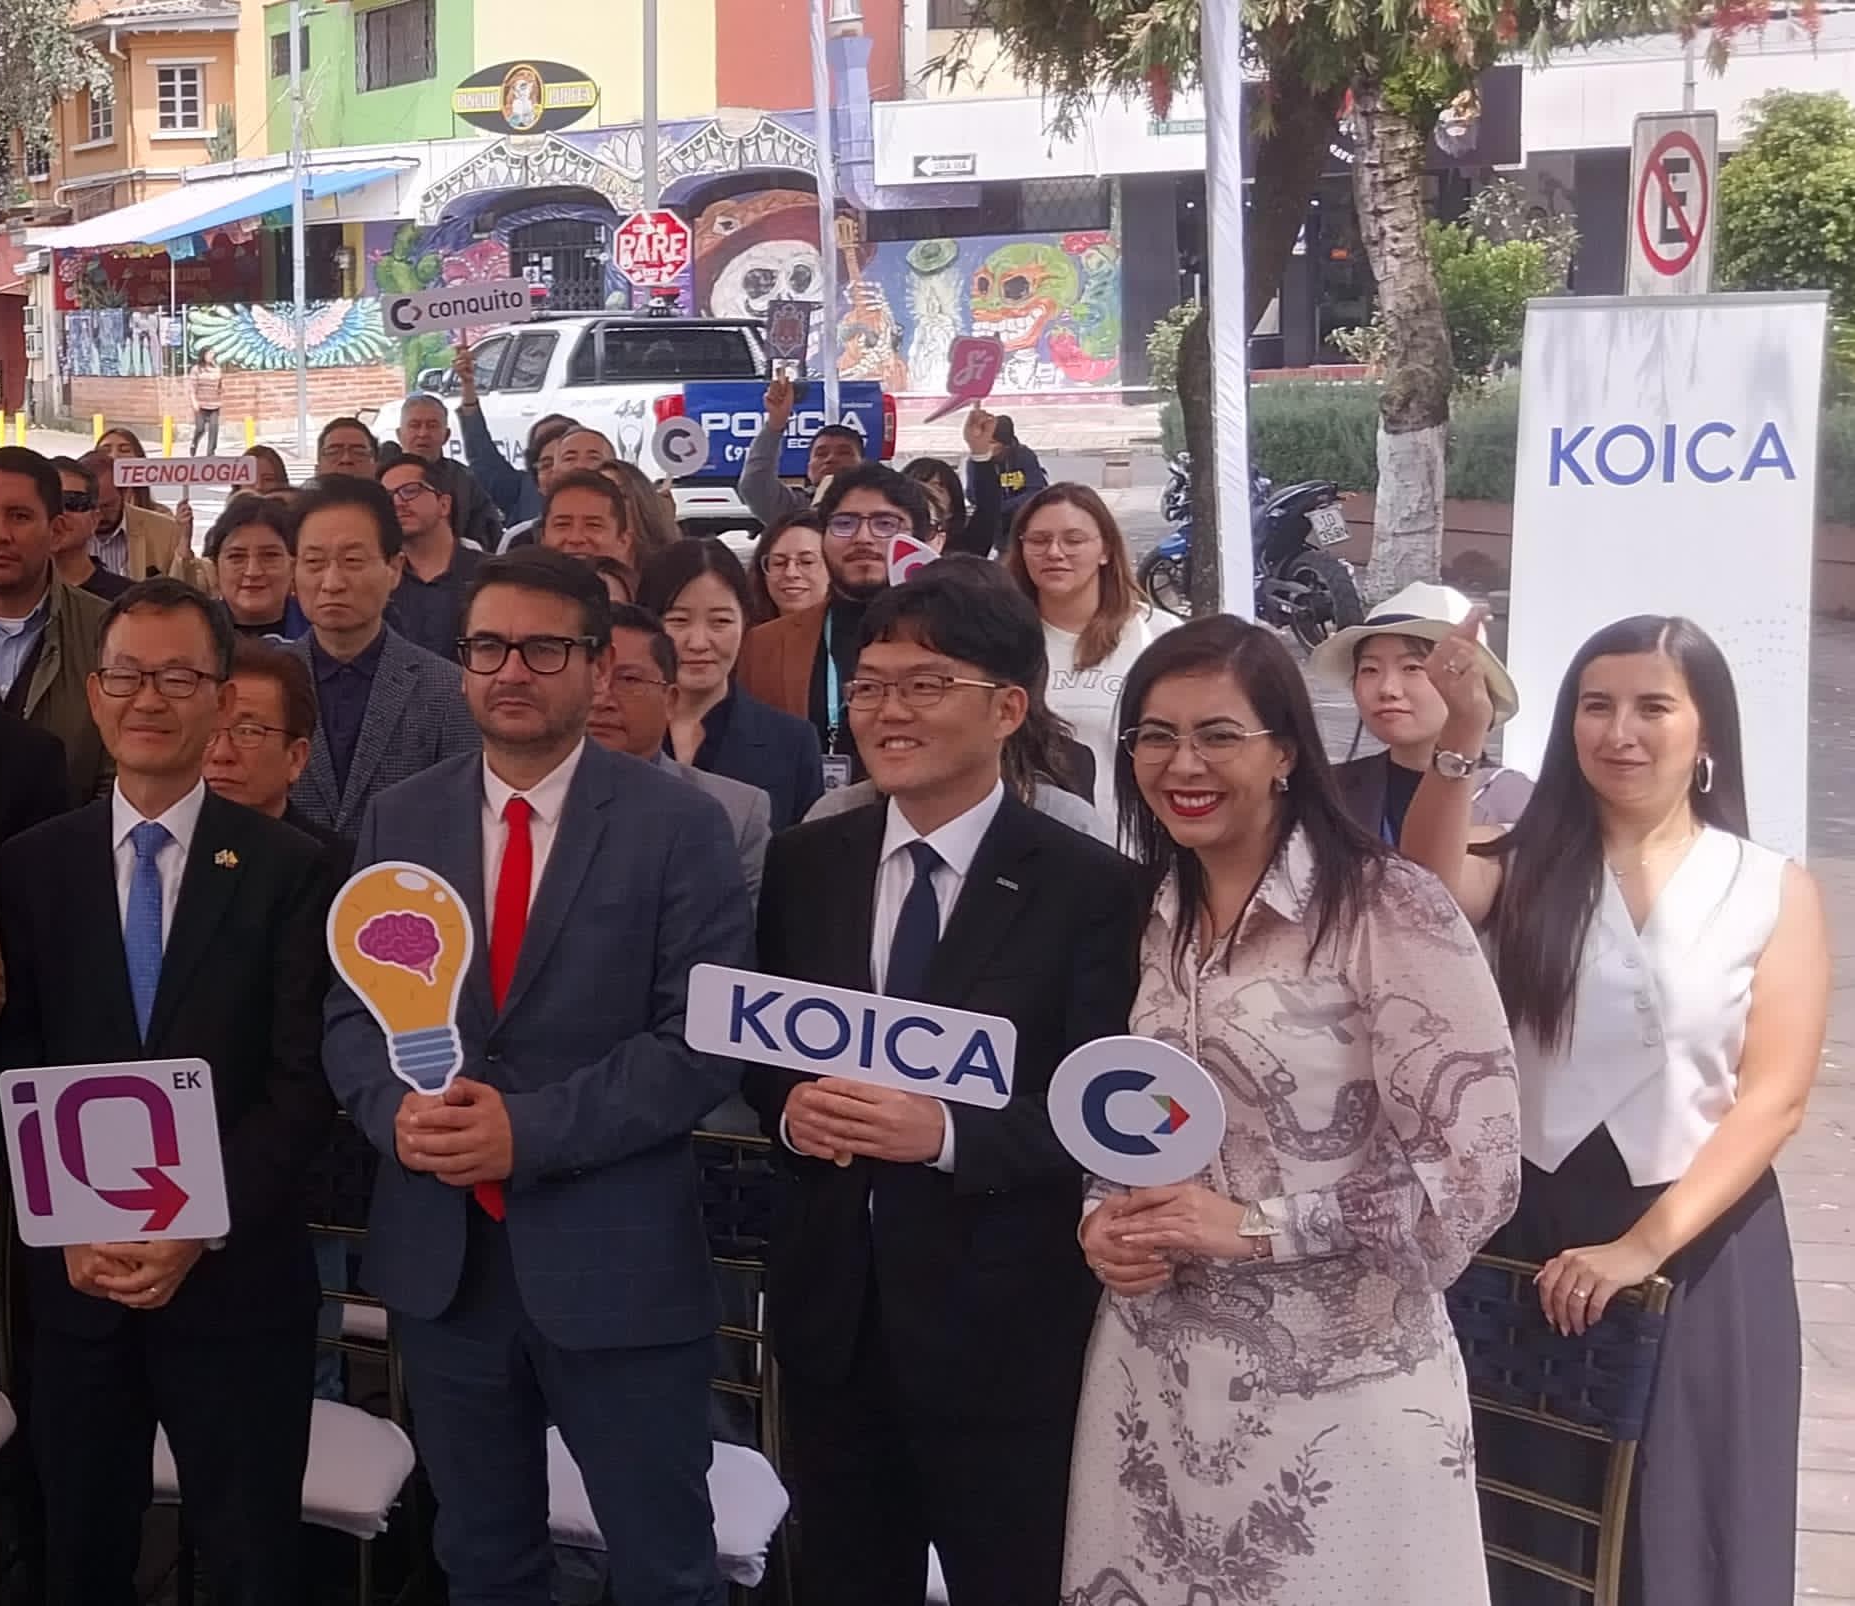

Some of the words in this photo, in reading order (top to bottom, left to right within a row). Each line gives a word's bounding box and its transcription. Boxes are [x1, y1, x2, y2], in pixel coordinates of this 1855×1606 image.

[619, 233, 686, 263] PARE
[428, 289, 523, 319] conquito
[1548, 421, 1796, 487] KOICA
[120, 458, 250, 483] TECNOLOGÍA
[729, 984, 1009, 1096] KOICA
[172, 1071, 203, 1090] EK
